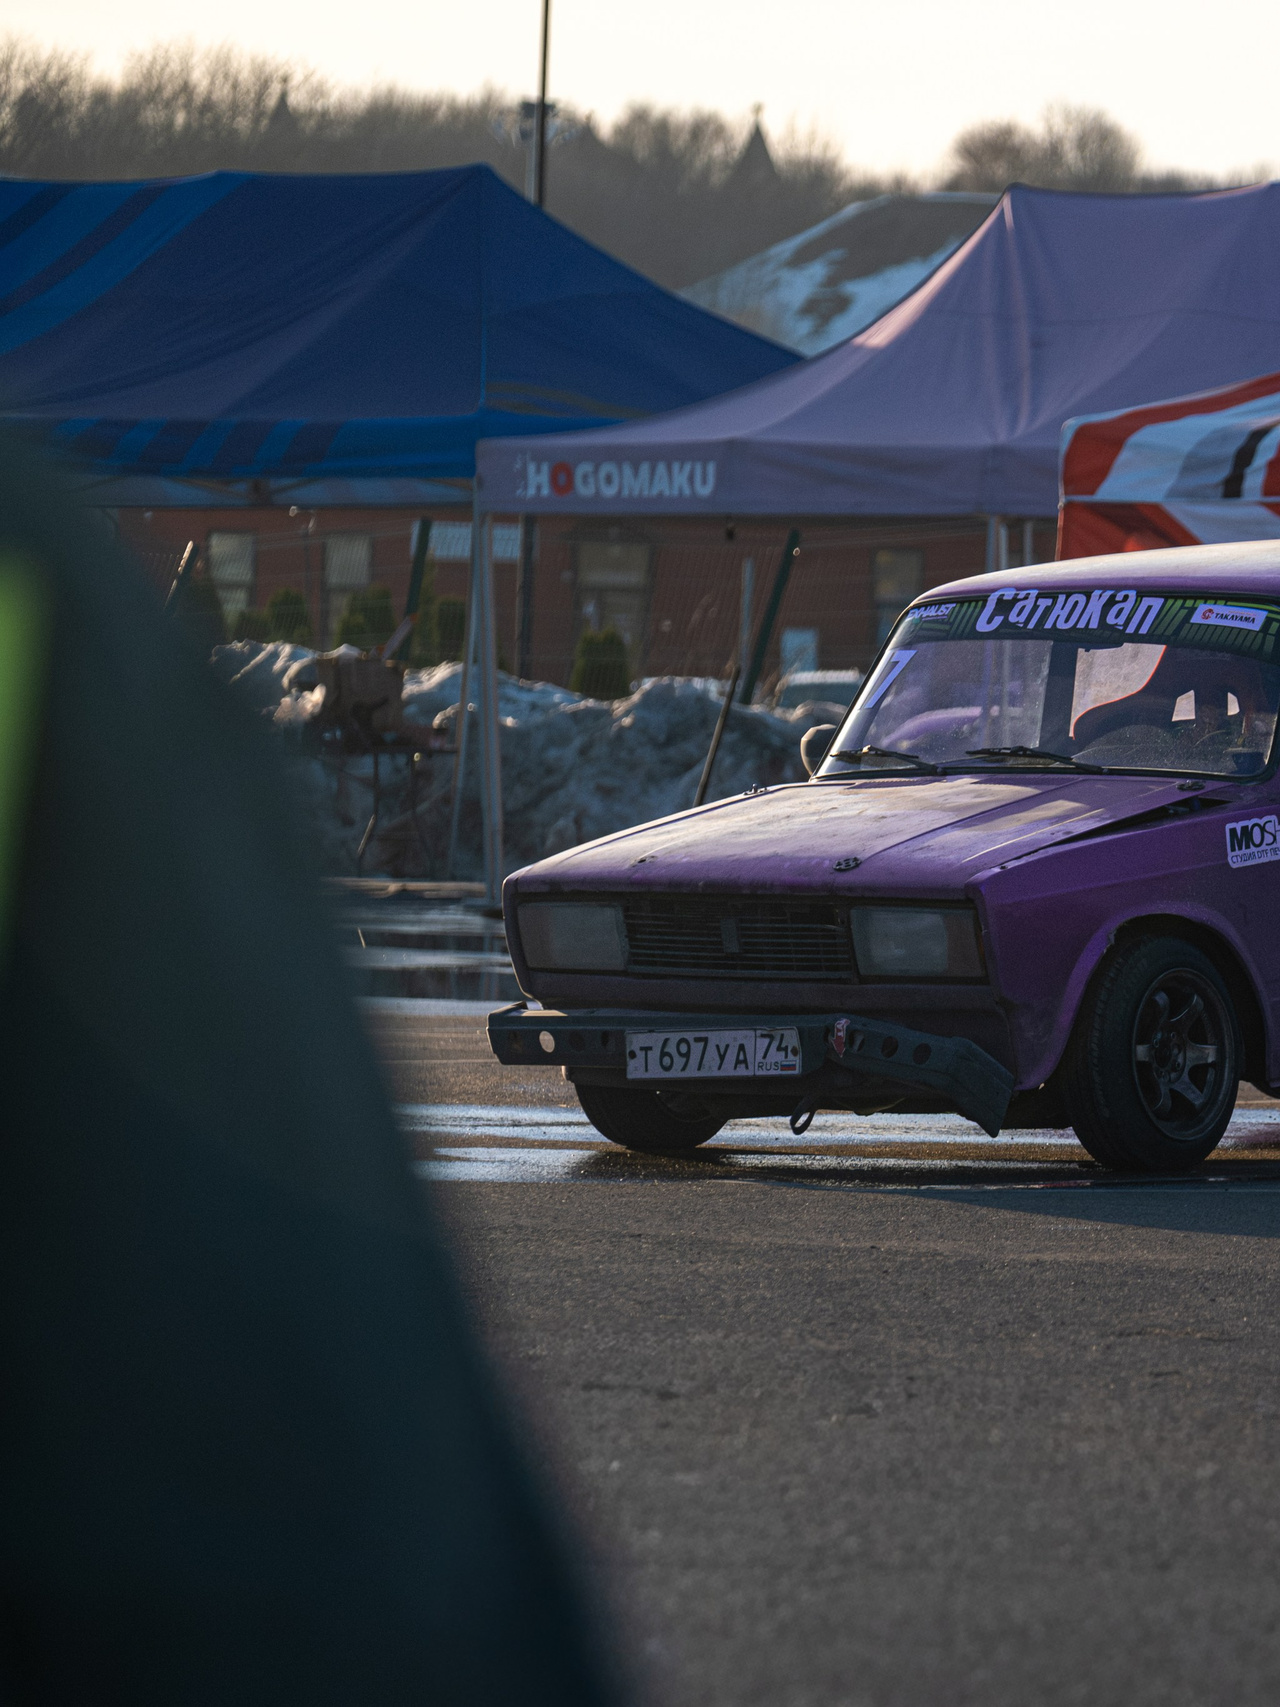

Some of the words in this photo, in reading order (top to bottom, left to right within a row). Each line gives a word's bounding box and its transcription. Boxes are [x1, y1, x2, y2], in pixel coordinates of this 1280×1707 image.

[526, 461, 717, 498] HOGOMAKU
[1214, 612, 1256, 624] TAKAYAMA
[1231, 852, 1257, 864] СТУДИЯ
[1256, 849, 1269, 859] DTF
[760, 1033, 790, 1060] 74
[757, 1061, 780, 1072] RUS
